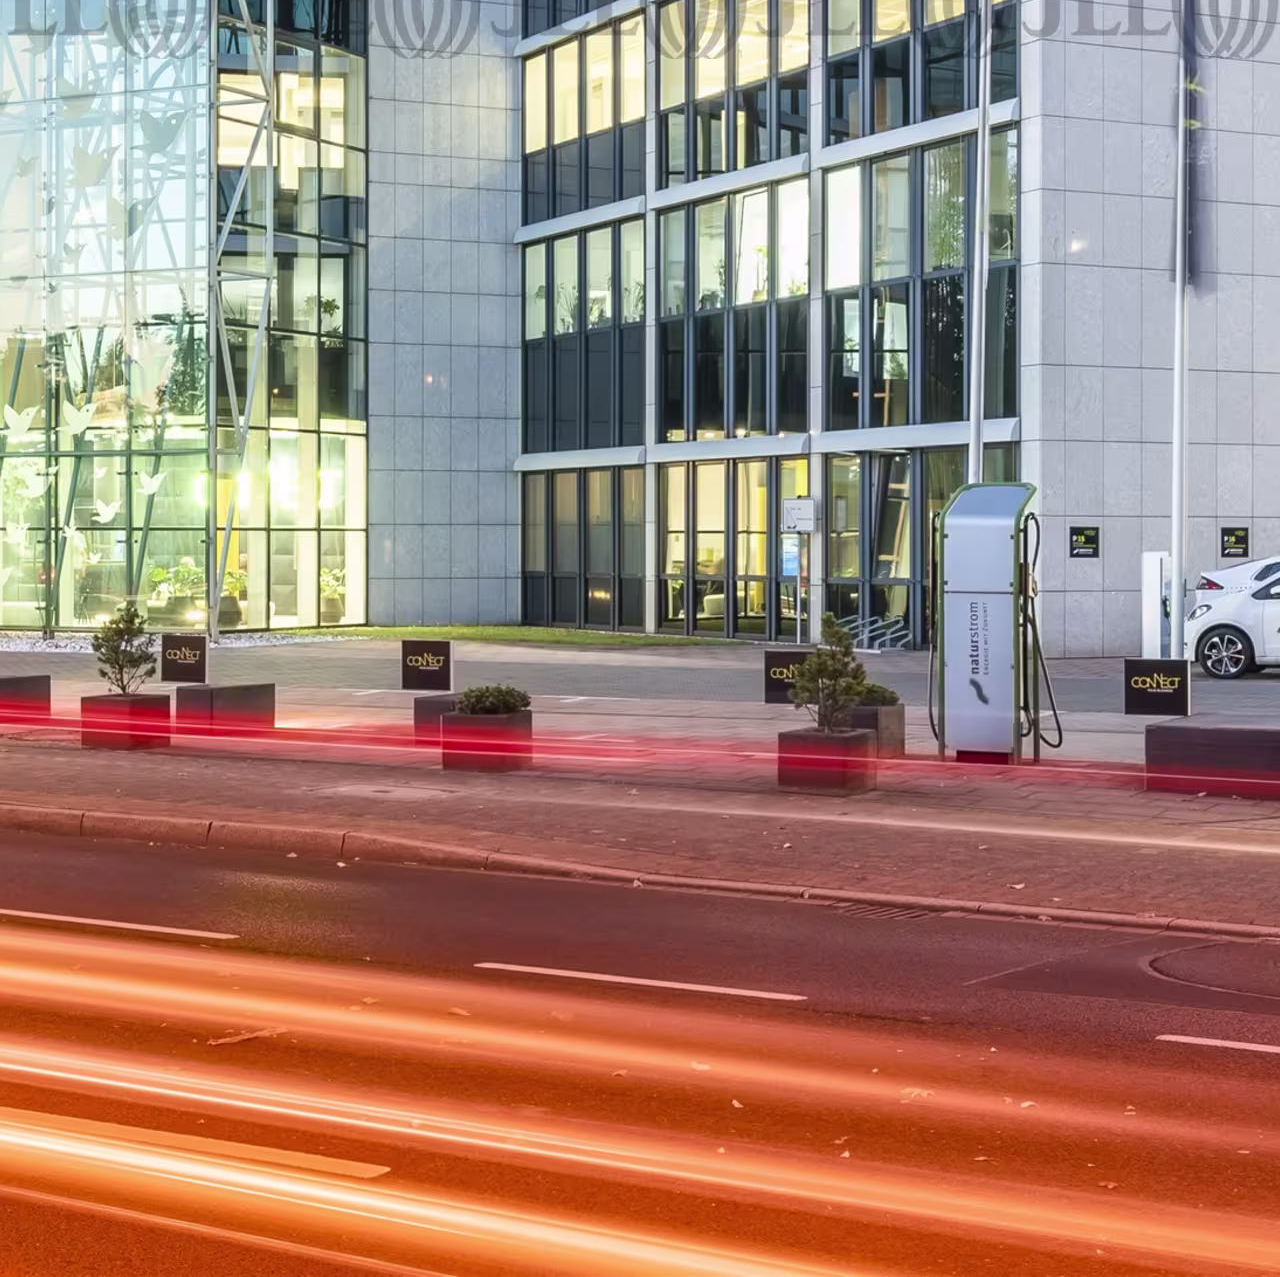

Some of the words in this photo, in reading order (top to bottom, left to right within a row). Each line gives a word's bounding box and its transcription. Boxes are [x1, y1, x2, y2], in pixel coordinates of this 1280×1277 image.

[968, 601, 980, 675] naturstrom
[165, 646, 200, 660] CONNECT
[406, 652, 445, 667] CONNECT
[1131, 672, 1181, 689] CONNECT
